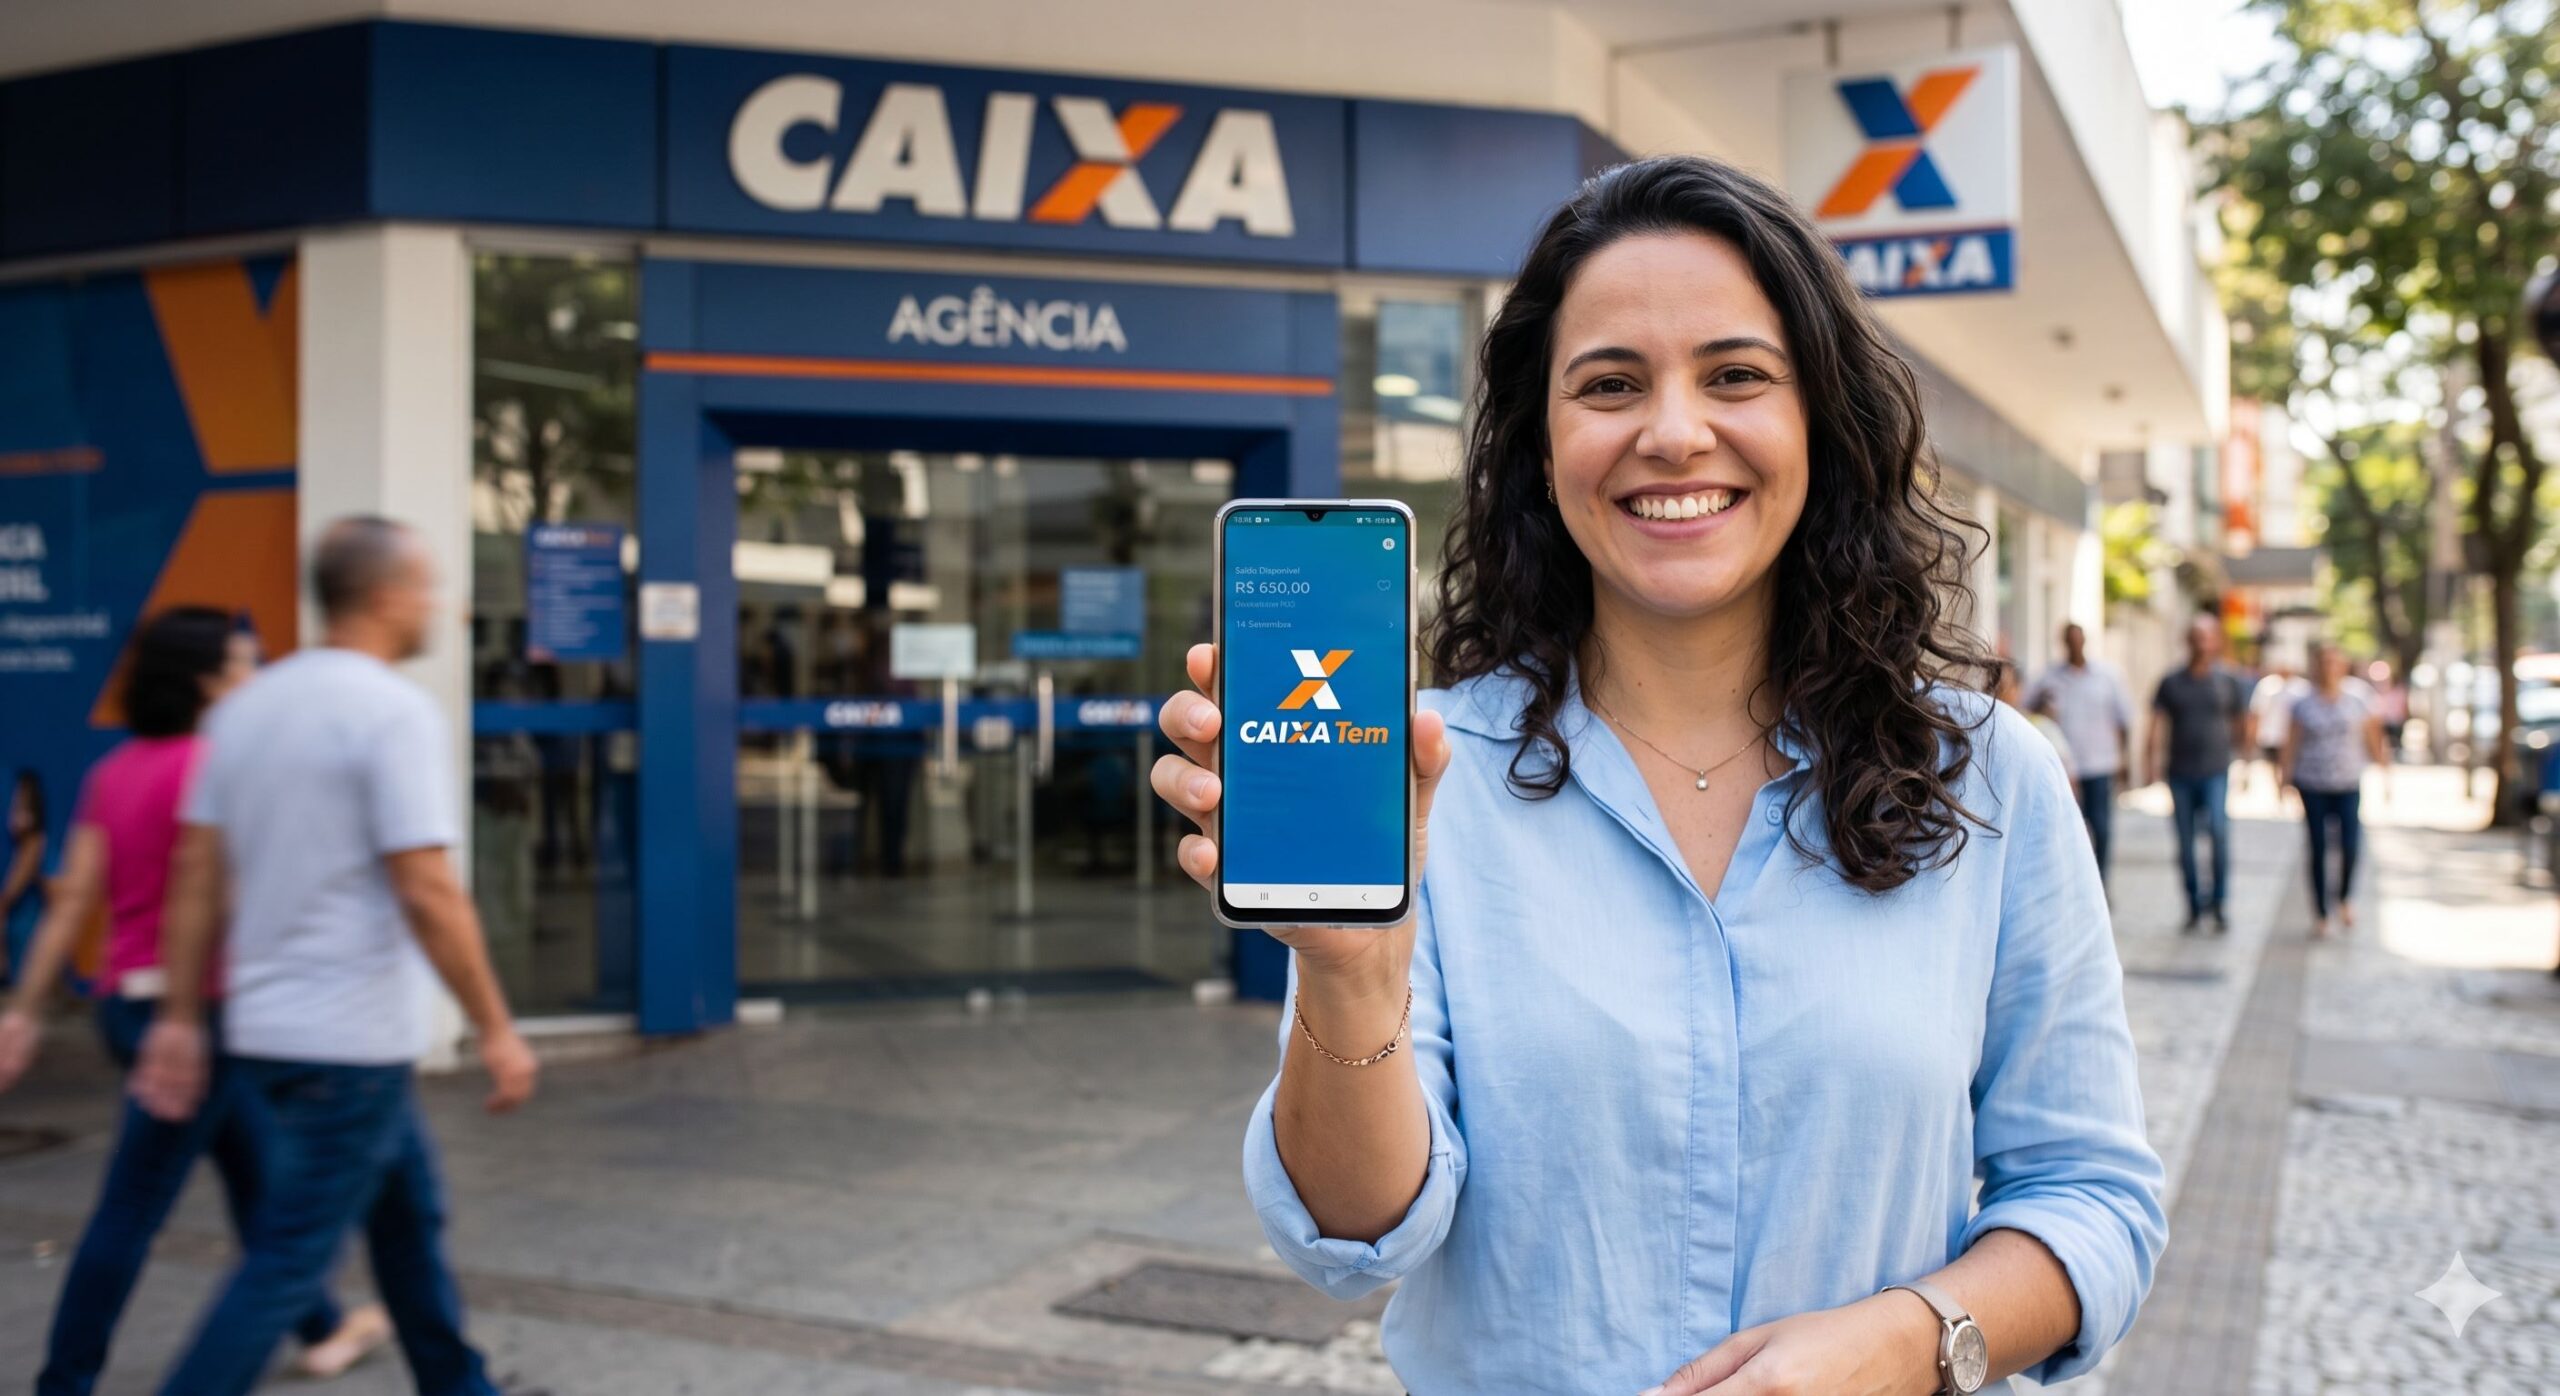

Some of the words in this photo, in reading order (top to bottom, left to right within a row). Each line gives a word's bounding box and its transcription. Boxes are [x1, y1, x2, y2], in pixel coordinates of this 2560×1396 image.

[728, 74, 1294, 238] CAIXA
[1847, 235, 1994, 288] AIXA
[886, 285, 1128, 352] AGÊNCIA
[1235, 581, 1254, 594] R$
[1260, 581, 1310, 595] 650,00
[1239, 720, 1330, 744] CAIXA
[1335, 720, 1389, 744] Tem
